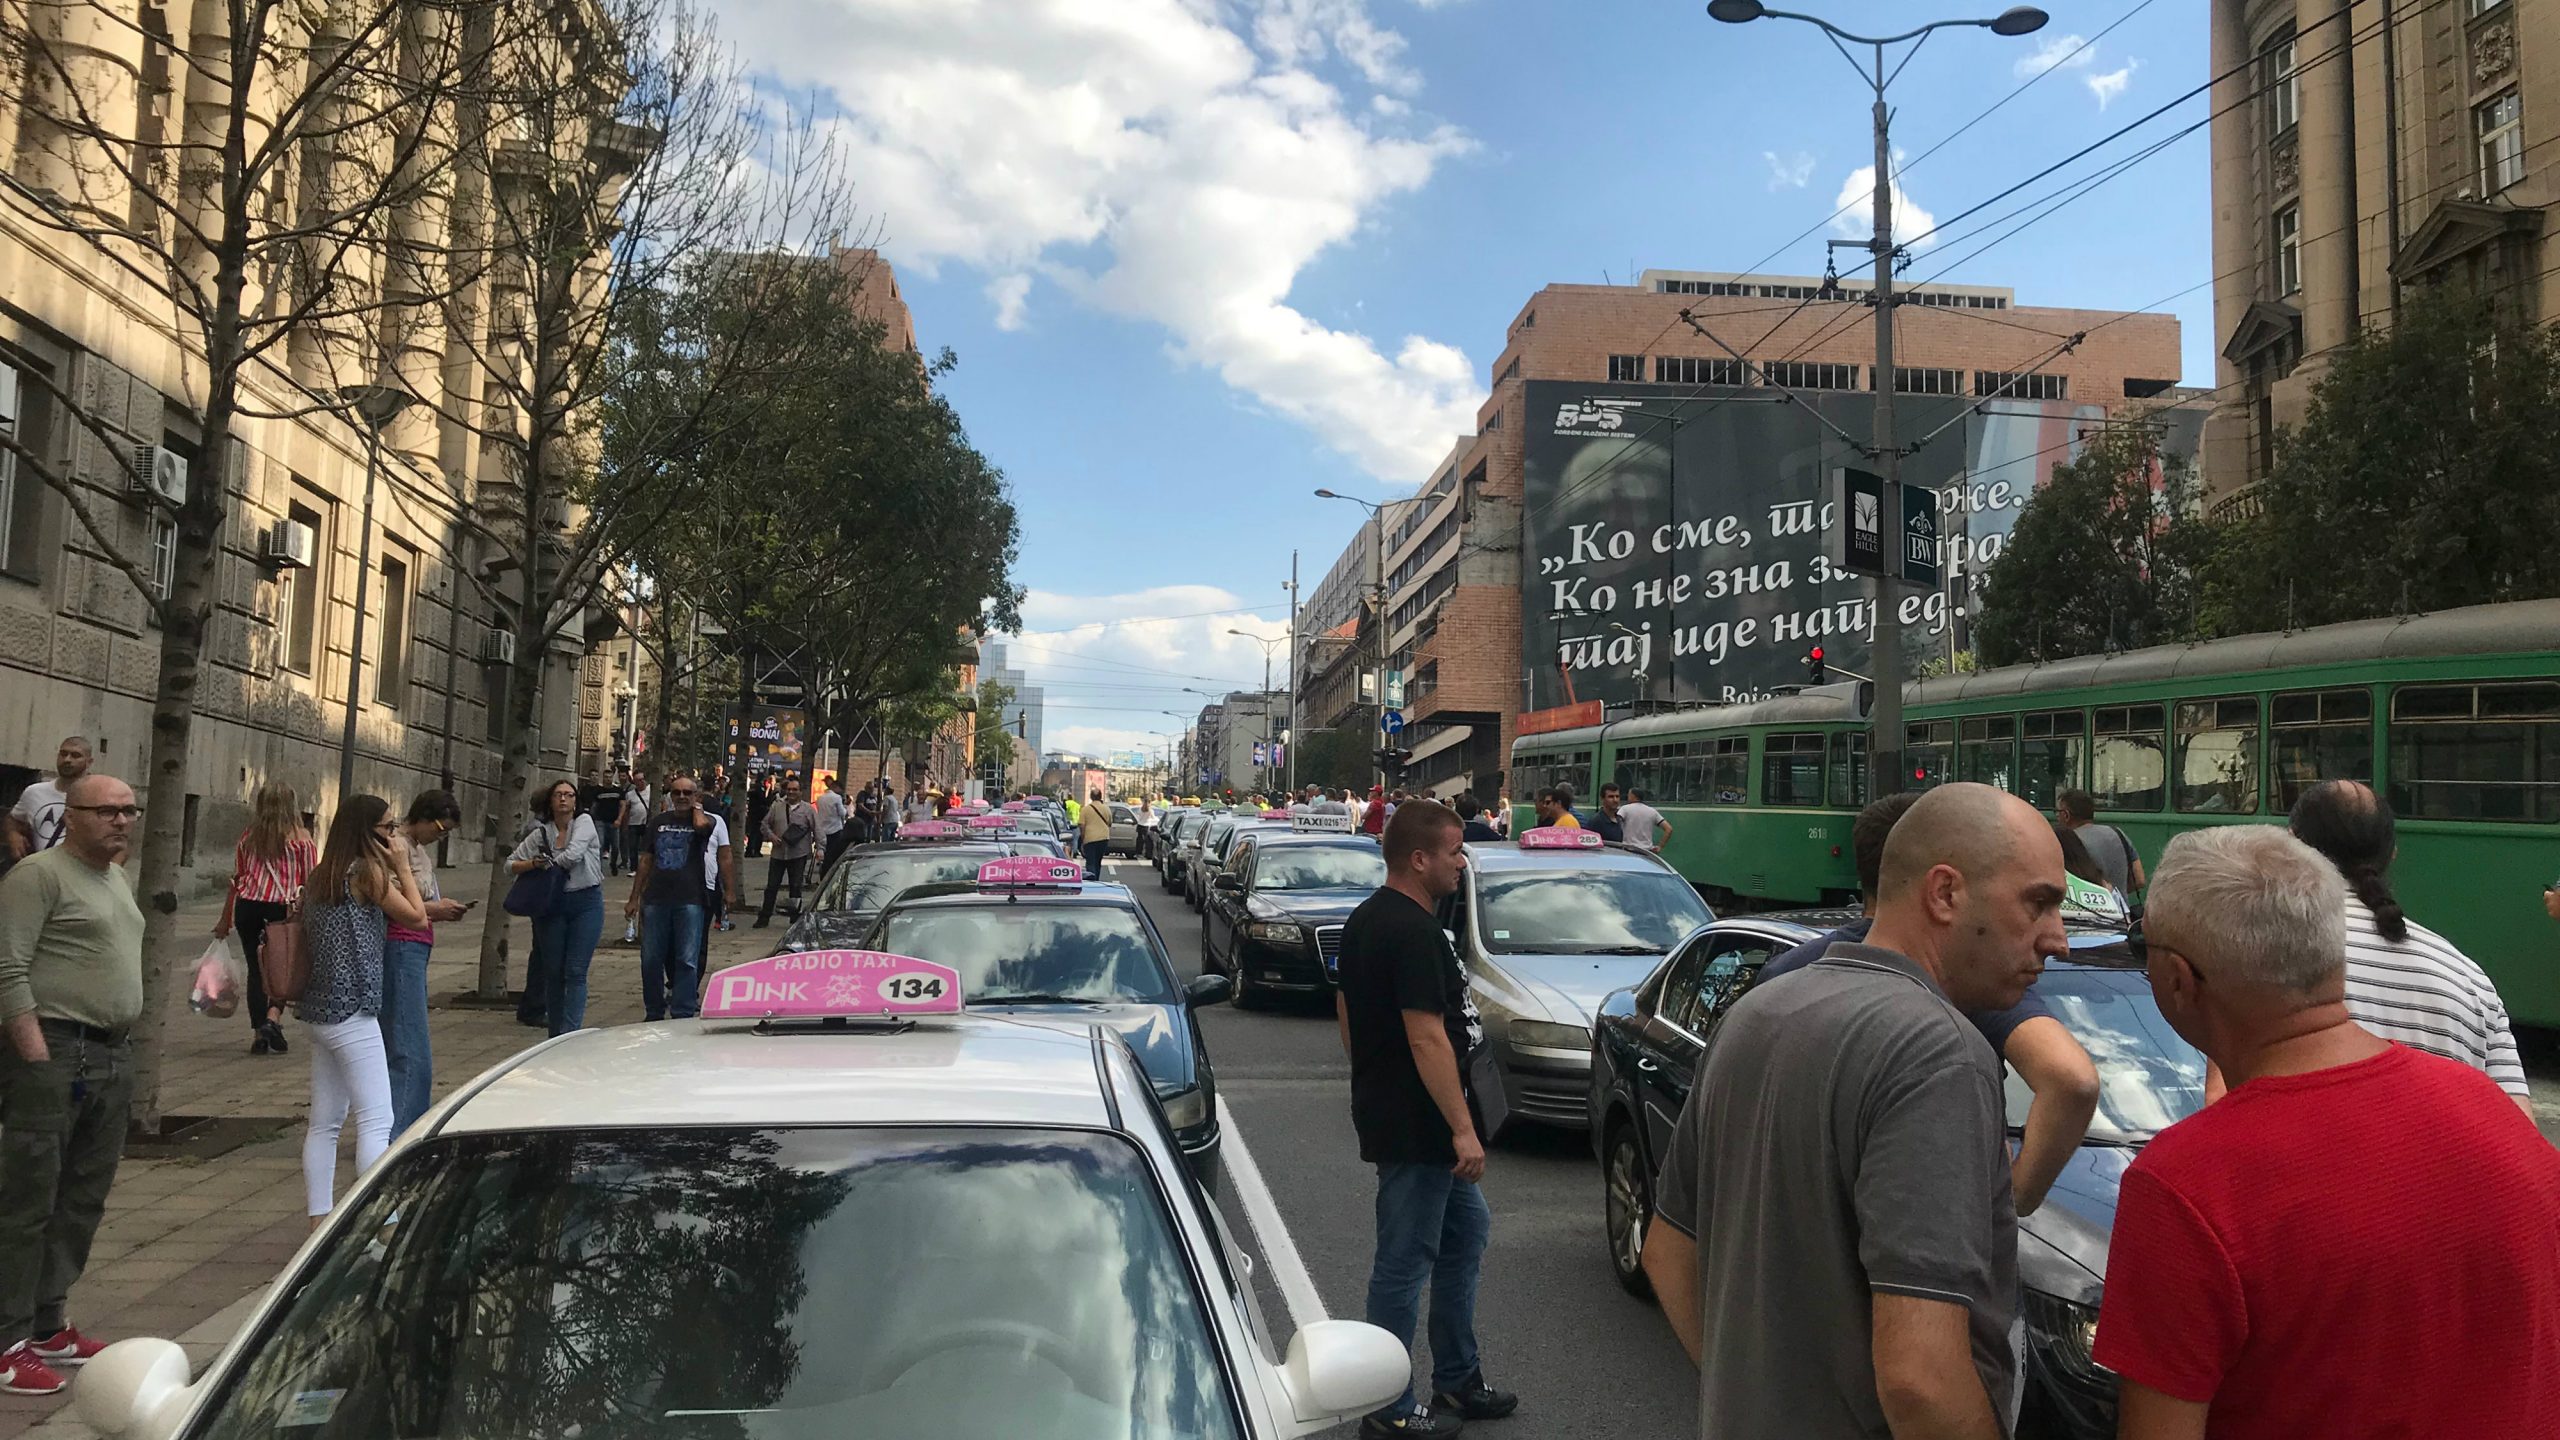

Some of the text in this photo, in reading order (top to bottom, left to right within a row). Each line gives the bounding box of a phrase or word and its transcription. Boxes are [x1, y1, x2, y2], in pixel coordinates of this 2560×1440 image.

[1855, 531, 1878, 544] EAGLE
[1855, 541, 1878, 553] HILLS
[1911, 537, 1933, 562] BW
[1632, 574, 1692, 609] не
[1705, 560, 1794, 598] зна
[1297, 818, 1322, 827] TAXI
[1528, 834, 1598, 846] PINK 285
[1005, 857, 1056, 865] RADIO TAXI
[984, 865, 1075, 880] PINK 1091
[2083, 893, 2107, 905] 323
[774, 953, 896, 970] RADIO TAXI
[718, 976, 942, 1010] PINK 134
